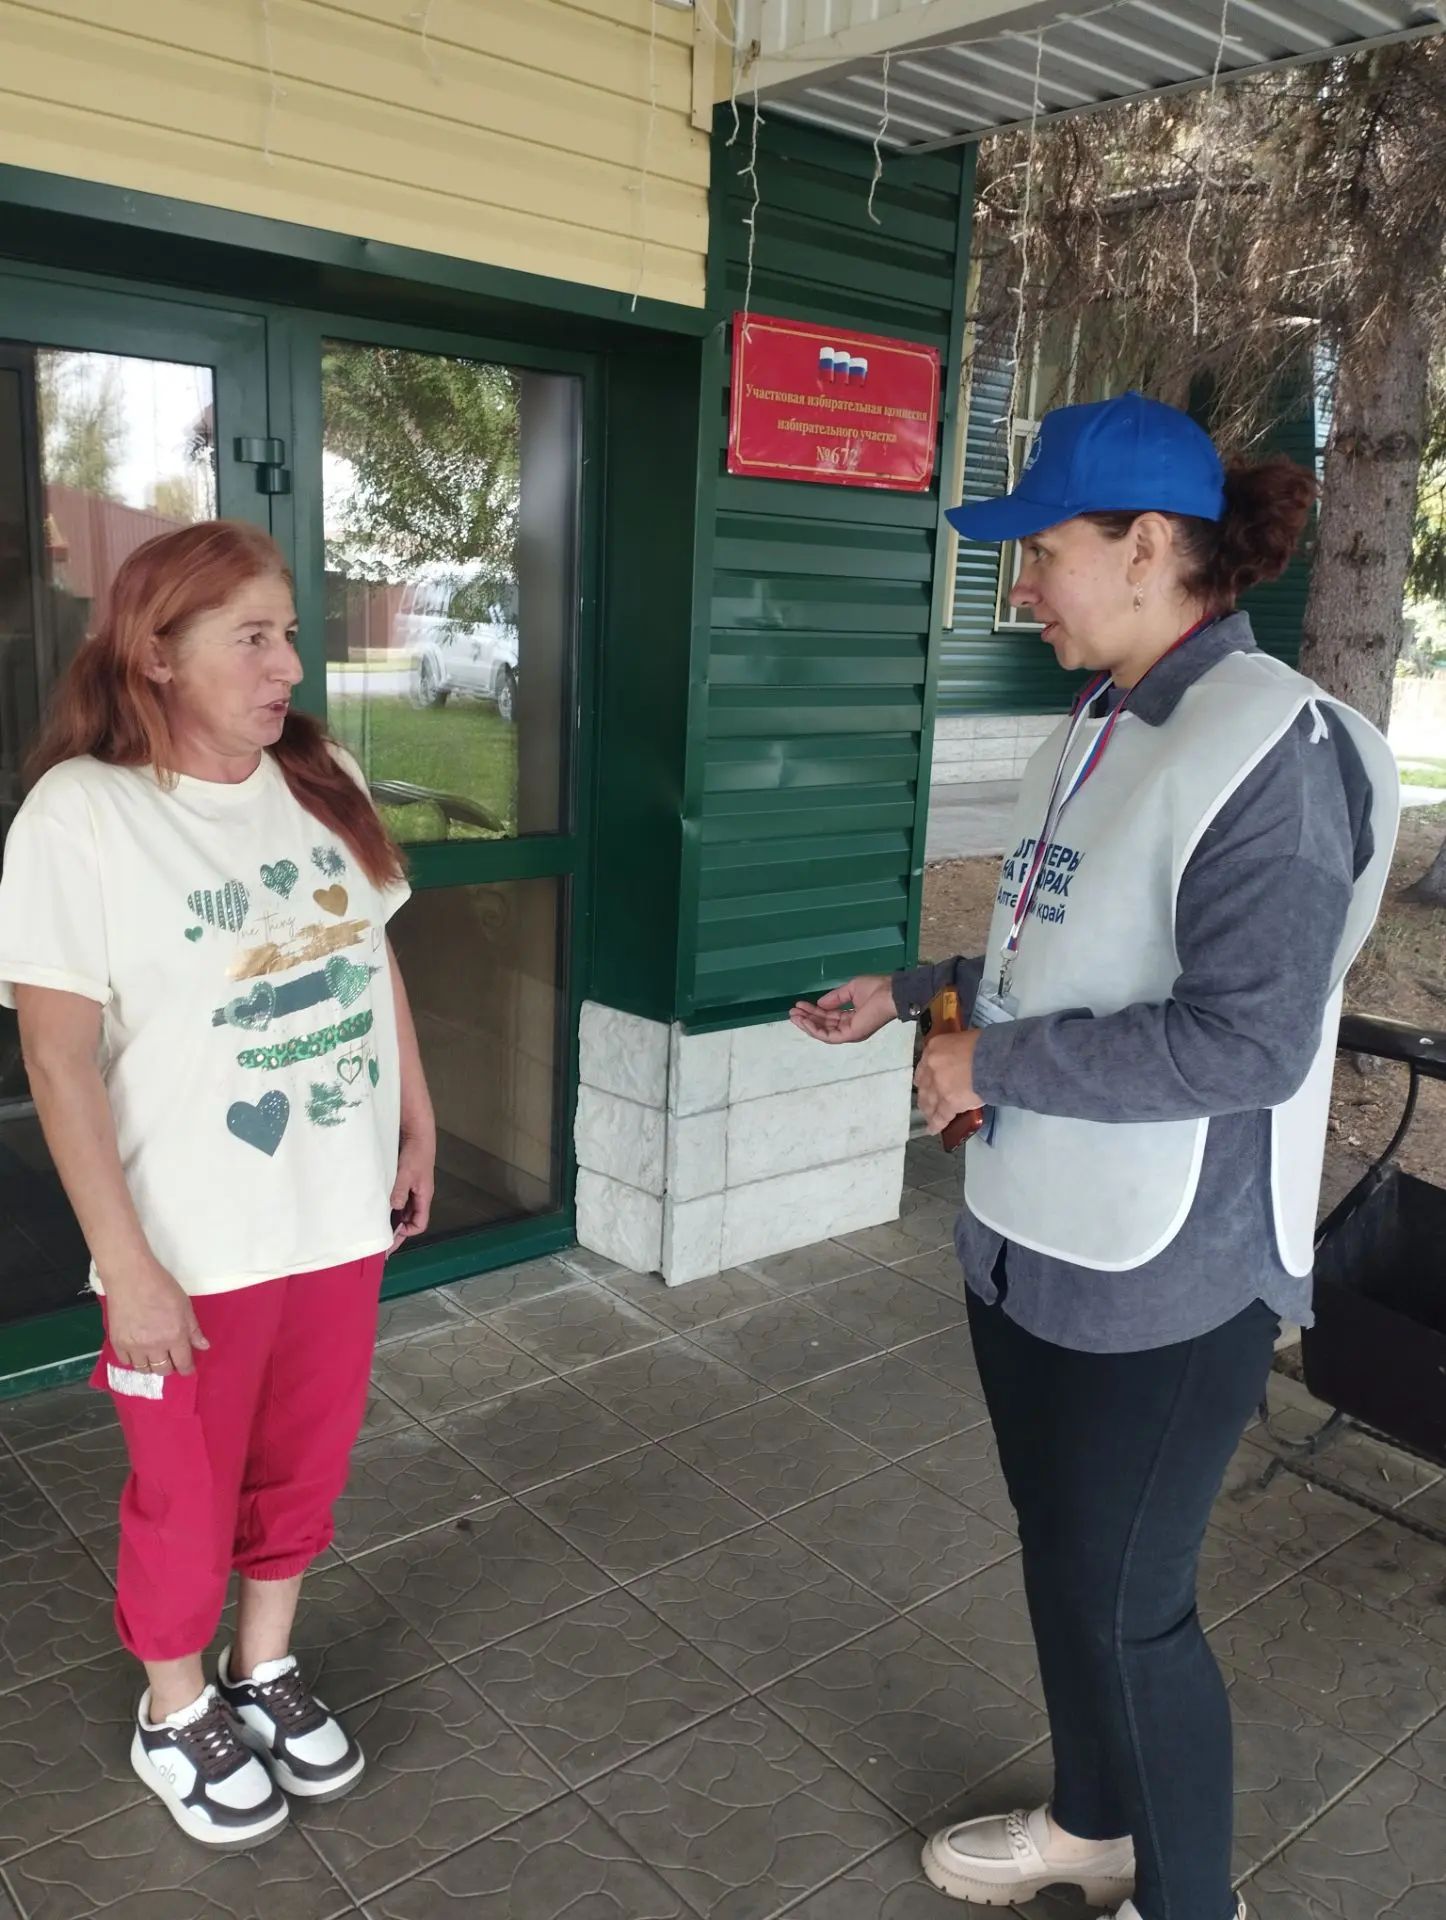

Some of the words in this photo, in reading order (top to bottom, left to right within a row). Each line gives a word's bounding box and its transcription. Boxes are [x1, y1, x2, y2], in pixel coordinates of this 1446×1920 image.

[745, 383, 805, 404] Участковая
[807, 394, 882, 415] избирательная
[777, 418, 859, 439] избирательного
[860, 429, 897, 443] участка
[1036, 902, 1066, 924] край
